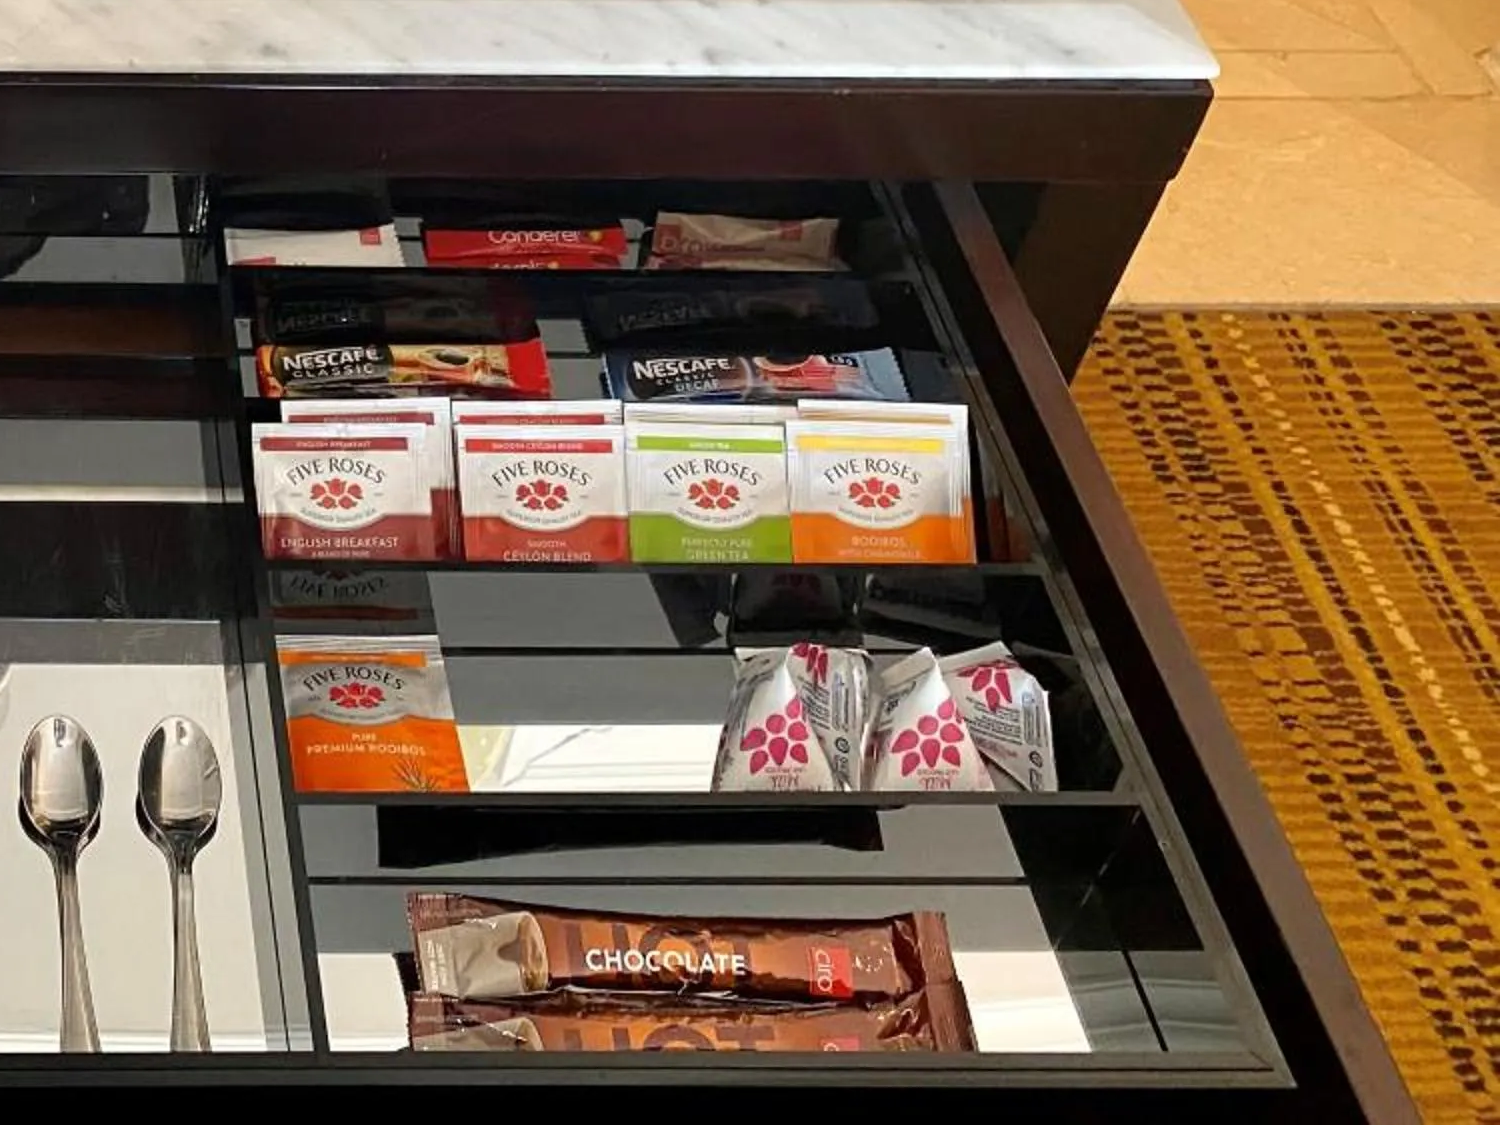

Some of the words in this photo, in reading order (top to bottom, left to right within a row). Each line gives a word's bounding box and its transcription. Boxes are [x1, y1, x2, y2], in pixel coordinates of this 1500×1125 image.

[293, 362, 374, 378] CLASSIC
[286, 457, 325, 486] FIVE
[329, 457, 387, 484] ROSES
[492, 460, 529, 487] FIVE
[533, 460, 593, 487] ROSES
[663, 458, 700, 486] FIVE
[704, 458, 763, 486] ROSES
[823, 458, 860, 485] FIVE
[865, 458, 922, 485] ROSES
[281, 538, 331, 548] ENGLISH
[333, 536, 400, 548] BREAKFAST
[503, 549, 551, 562] CEYLON
[553, 550, 592, 562] BLEND
[303, 666, 342, 691] FIVE
[345, 666, 405, 691] ROSES
[306, 742, 366, 756] PREMIUM
[367, 743, 426, 756] ROOIBOS
[351, 733, 377, 742] PURE
[585, 948, 746, 976] CHOCOLATE
[814, 948, 834, 993] ciro
